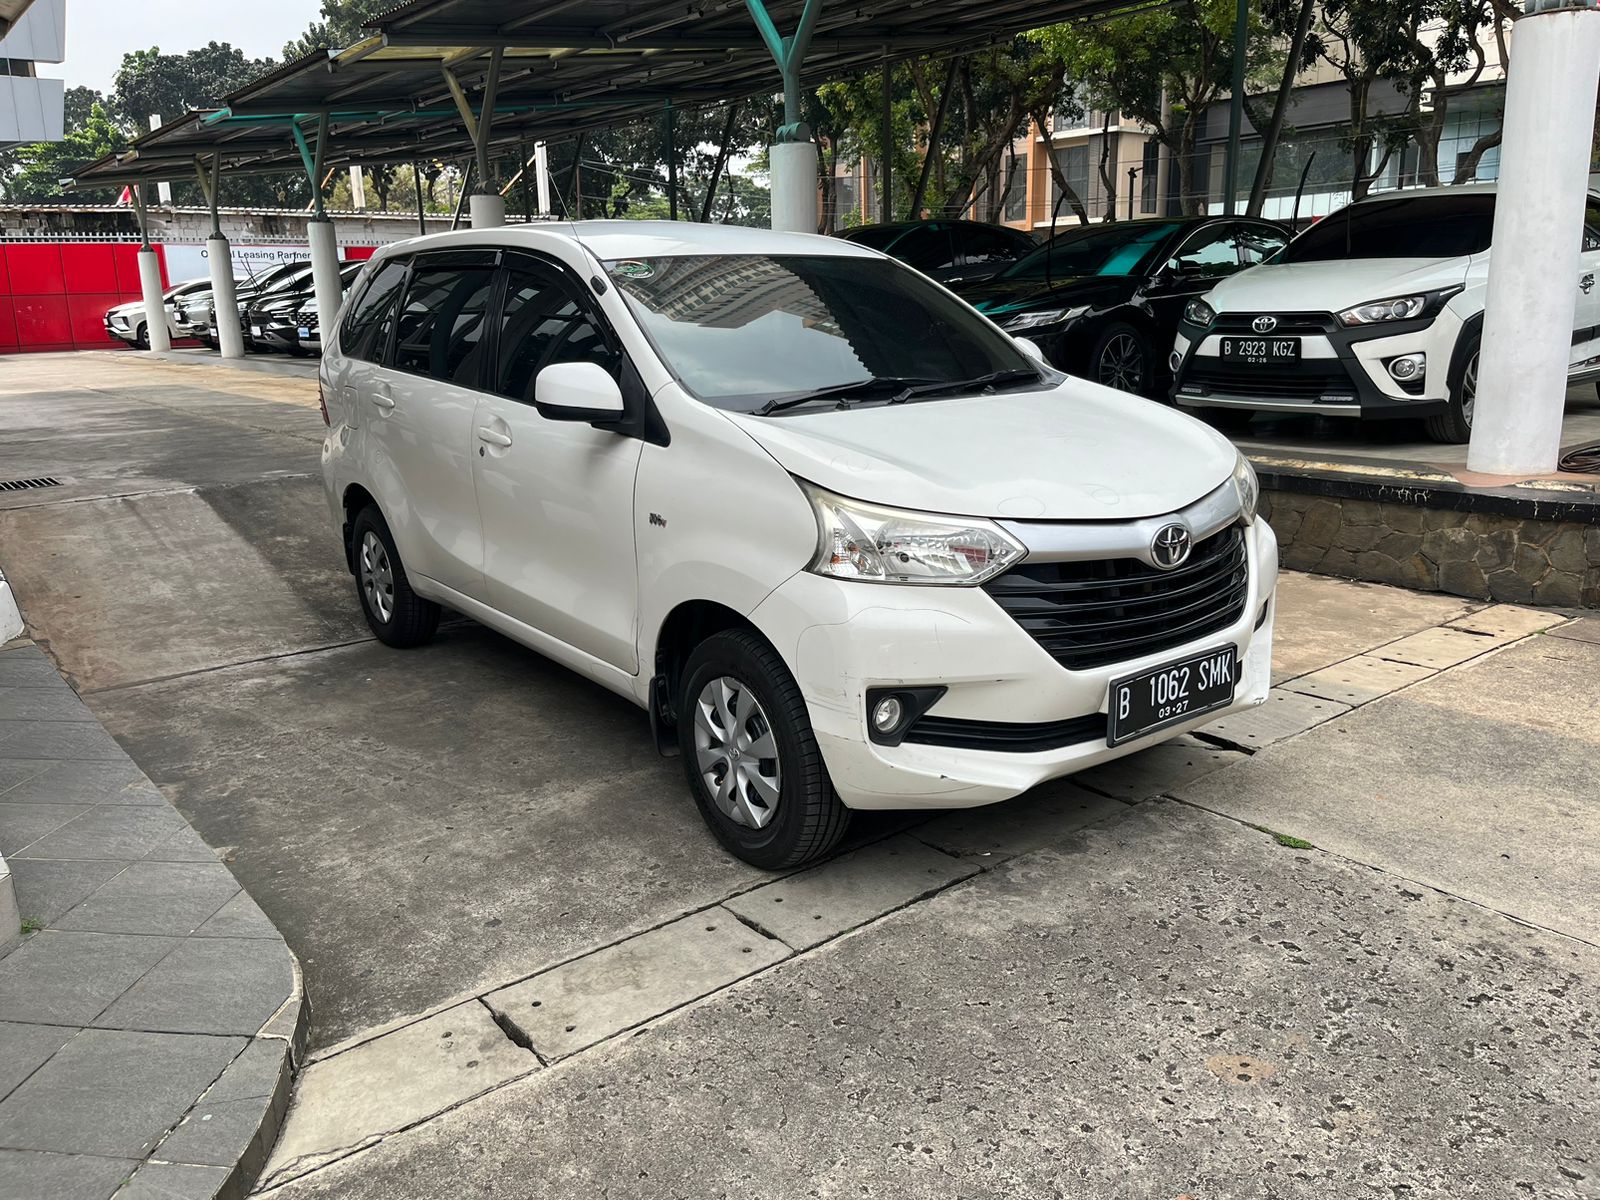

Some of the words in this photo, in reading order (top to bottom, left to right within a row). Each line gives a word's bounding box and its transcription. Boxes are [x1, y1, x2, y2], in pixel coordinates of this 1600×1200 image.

[238, 250, 275, 260] Leasing
[278, 250, 311, 259] Partner
[1224, 341, 1232, 355] B
[1239, 341, 1266, 356] 2923
[1272, 341, 1296, 356] KGZ
[1119, 687, 1131, 720] B
[1149, 666, 1190, 707] 1062
[1198, 652, 1231, 691] SMK
